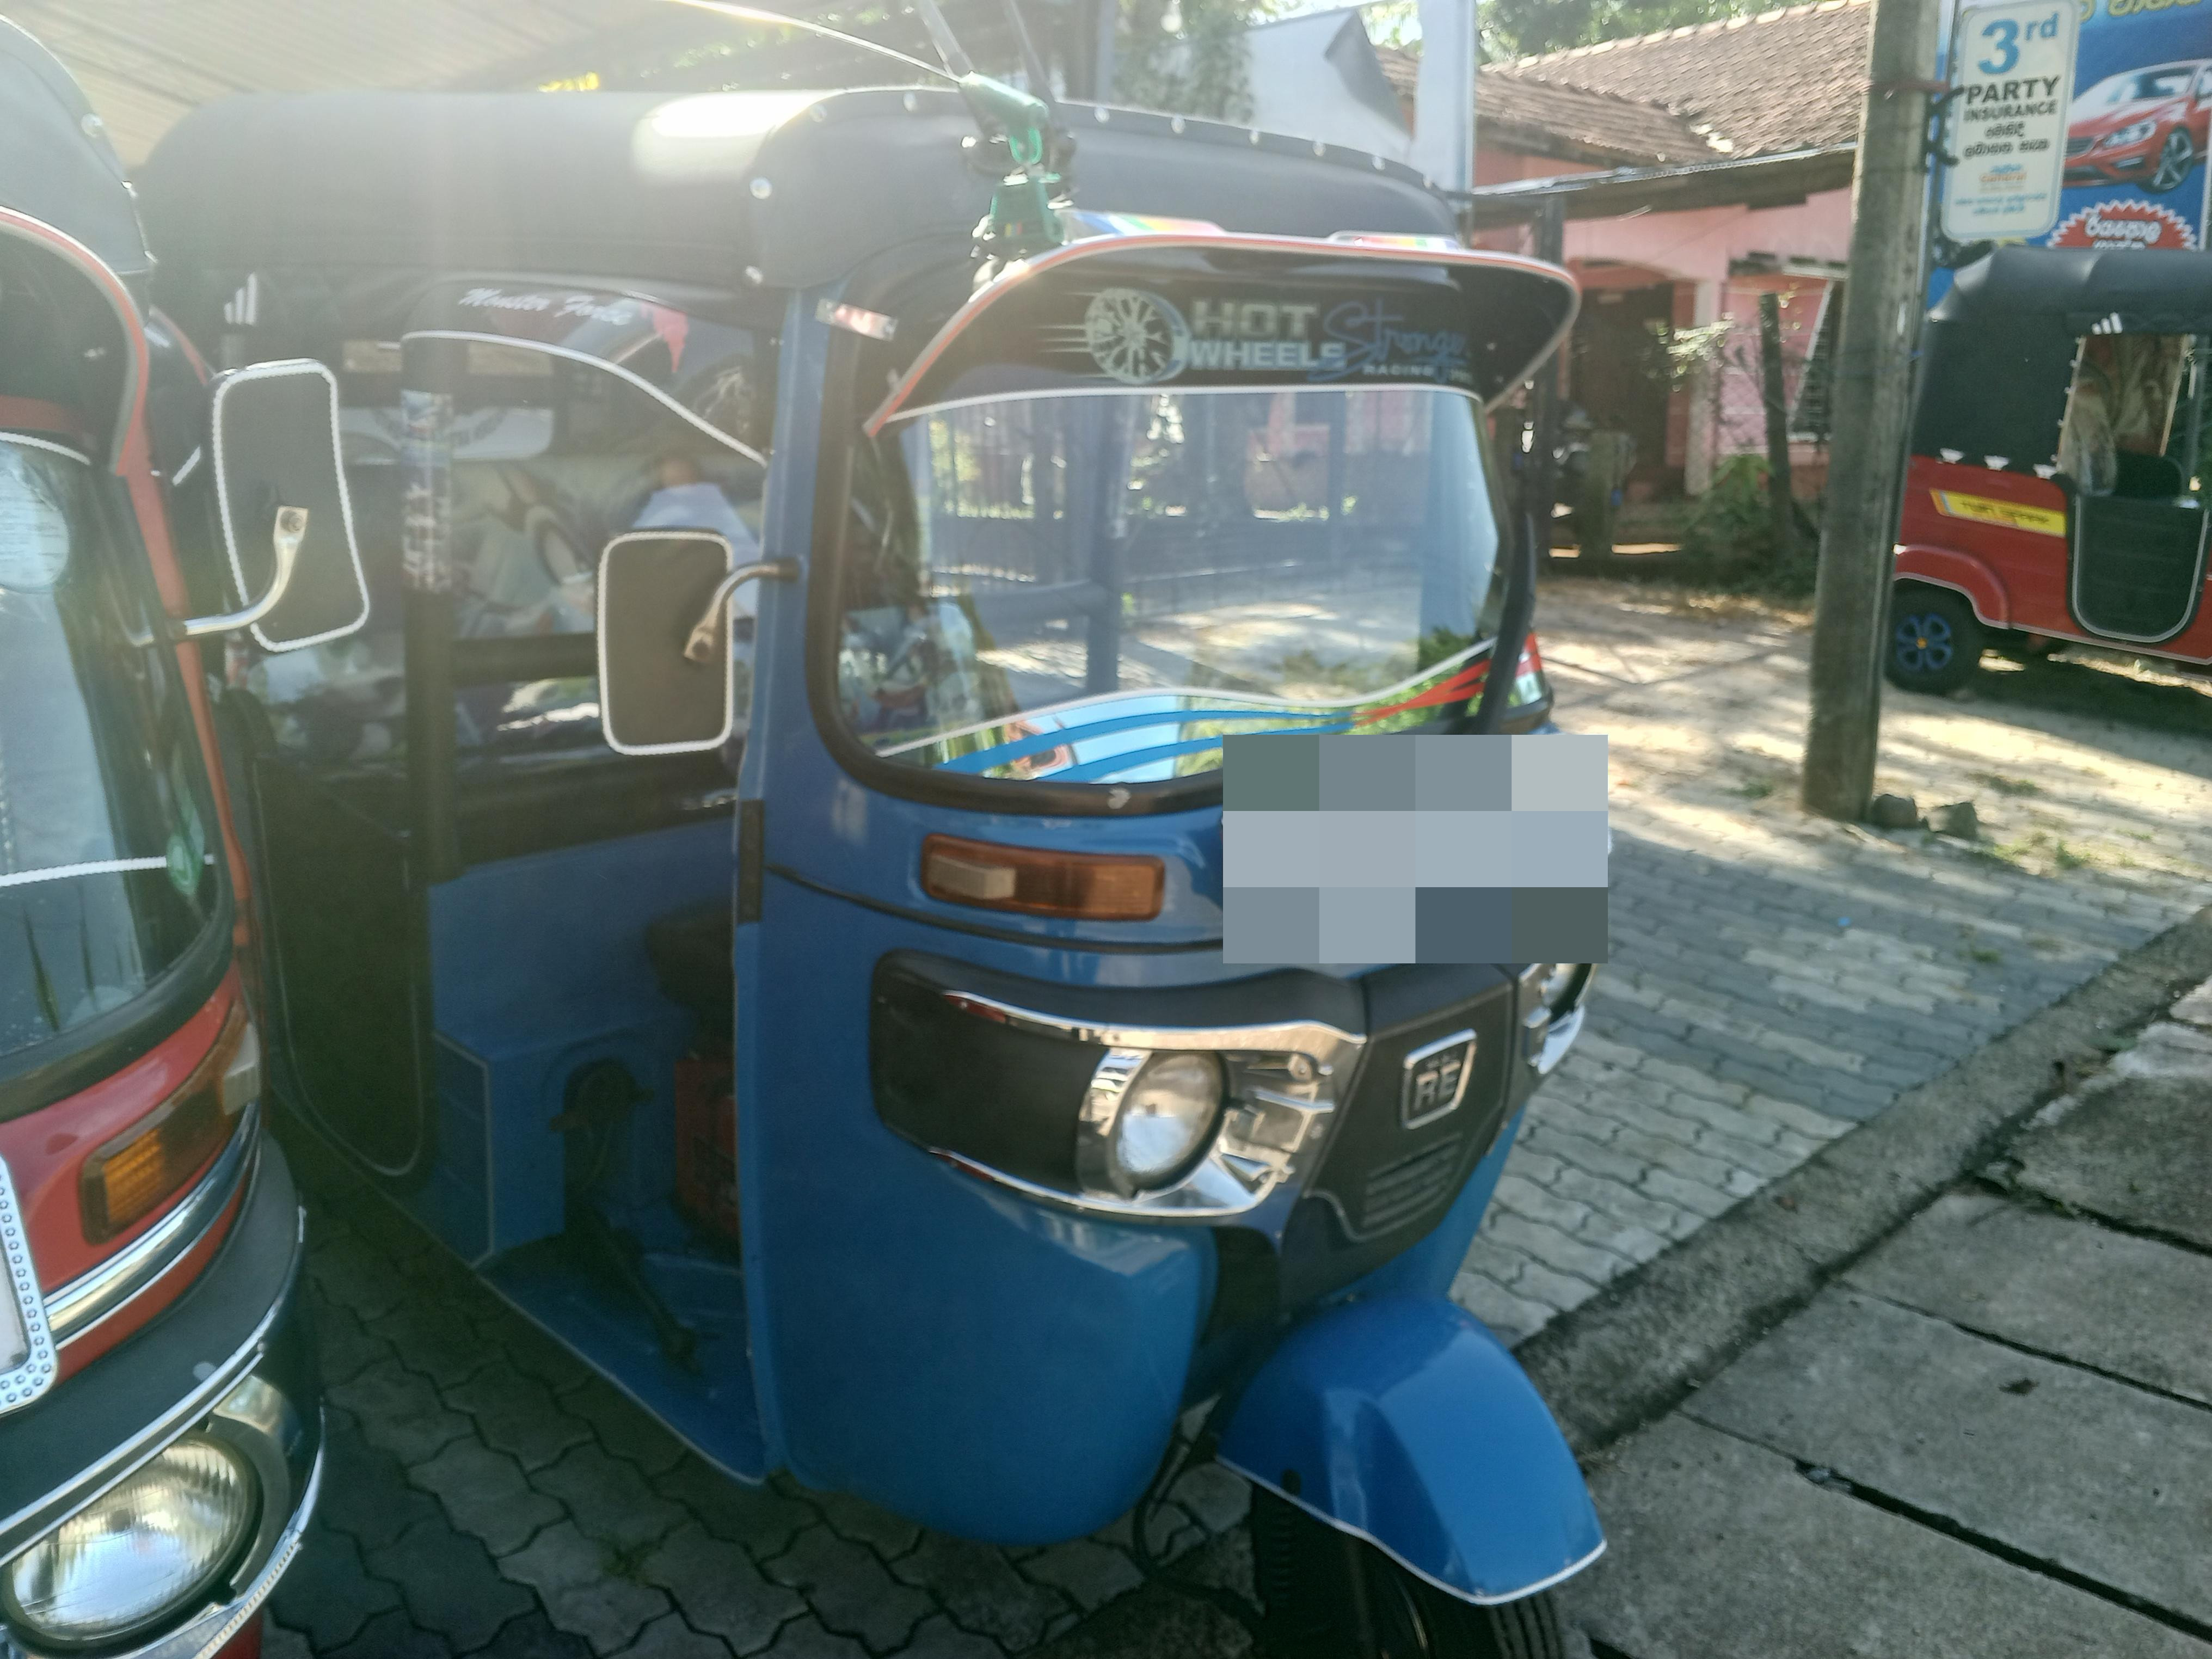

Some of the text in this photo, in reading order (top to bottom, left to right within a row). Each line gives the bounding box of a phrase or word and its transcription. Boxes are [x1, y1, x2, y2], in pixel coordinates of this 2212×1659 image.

[1967, 76, 2061, 105] PARTY
[1963, 100, 2058, 122] INSURANCE
[1195, 299, 1318, 339] HOT
[1187, 341, 1348, 371] WHEELS
[1414, 1060, 1461, 1110] RE
